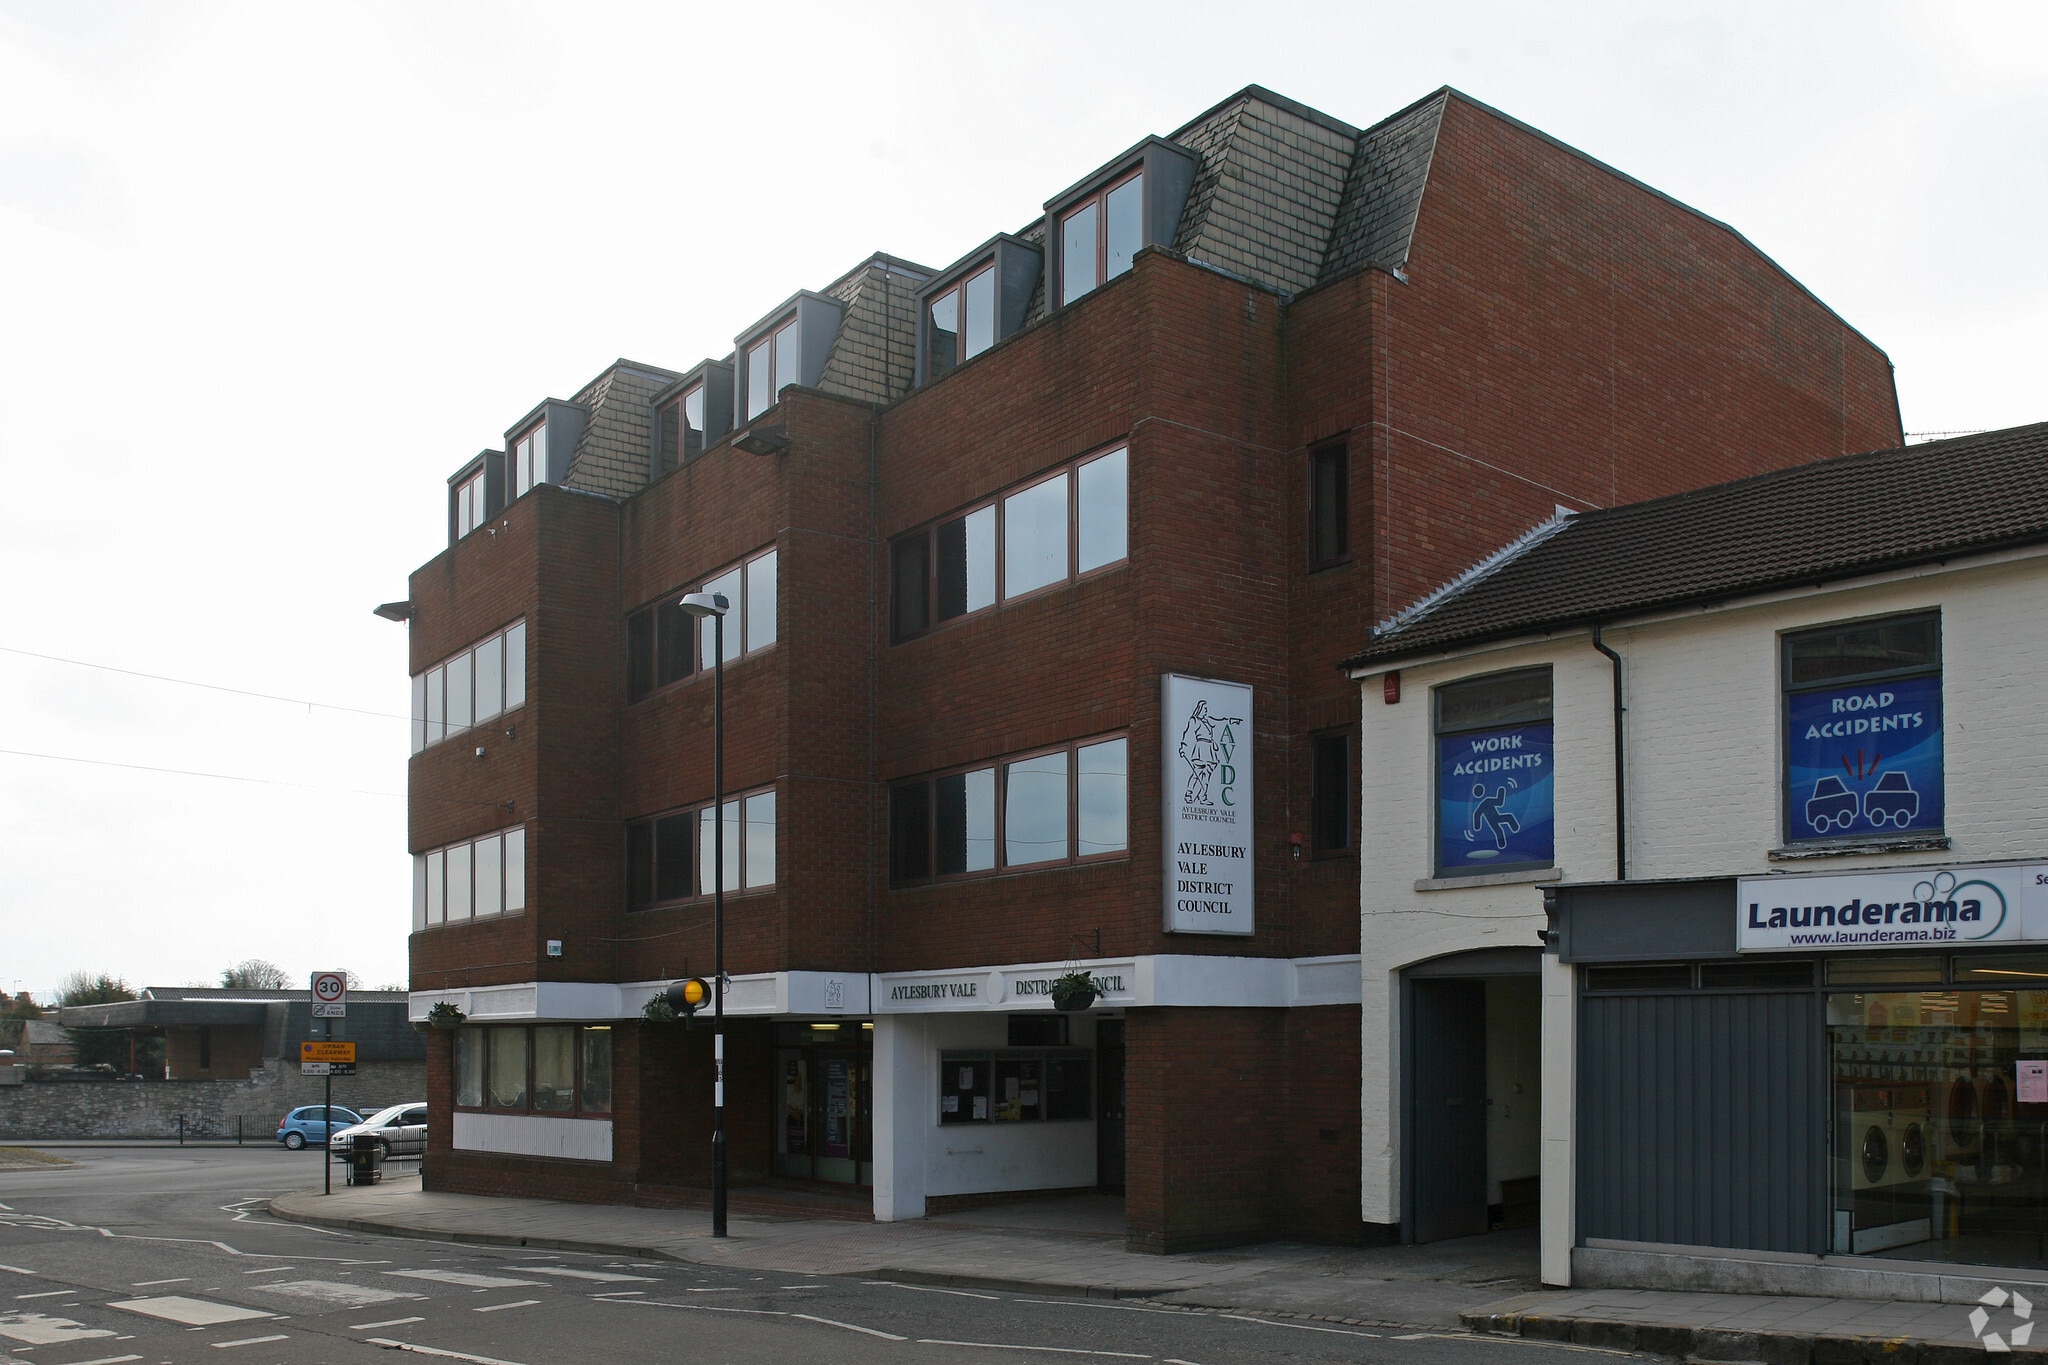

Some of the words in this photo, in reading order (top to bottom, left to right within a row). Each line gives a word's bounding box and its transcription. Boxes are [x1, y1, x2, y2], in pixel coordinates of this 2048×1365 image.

[1832, 692, 1895, 714] ROAD
[1804, 711, 1923, 740] ACCIDENTS
[1471, 734, 1522, 754] WORK
[1453, 752, 1542, 776] ACCIDENTS
[1182, 806, 1218, 816] AYLESBURY
[1220, 809, 1236, 818] VALE
[1182, 813, 1208, 822] DISTRICT
[1209, 815, 1237, 824] COUNCIL
[1177, 842, 1247, 859] AYLESBURY
[1177, 861, 1208, 875] VALE
[1177, 880, 1234, 895] DISTRICT
[1177, 899, 1232, 914] COUNCIL
[1748, 898, 1982, 929] Launderama
[1790, 926, 1957, 944] www.launderama.biz
[319, 981, 340, 993] 30
[891, 984, 948, 1000] AYLESBURY
[949, 982, 977, 998] VALE
[1016, 979, 1059, 996] DISTRI
